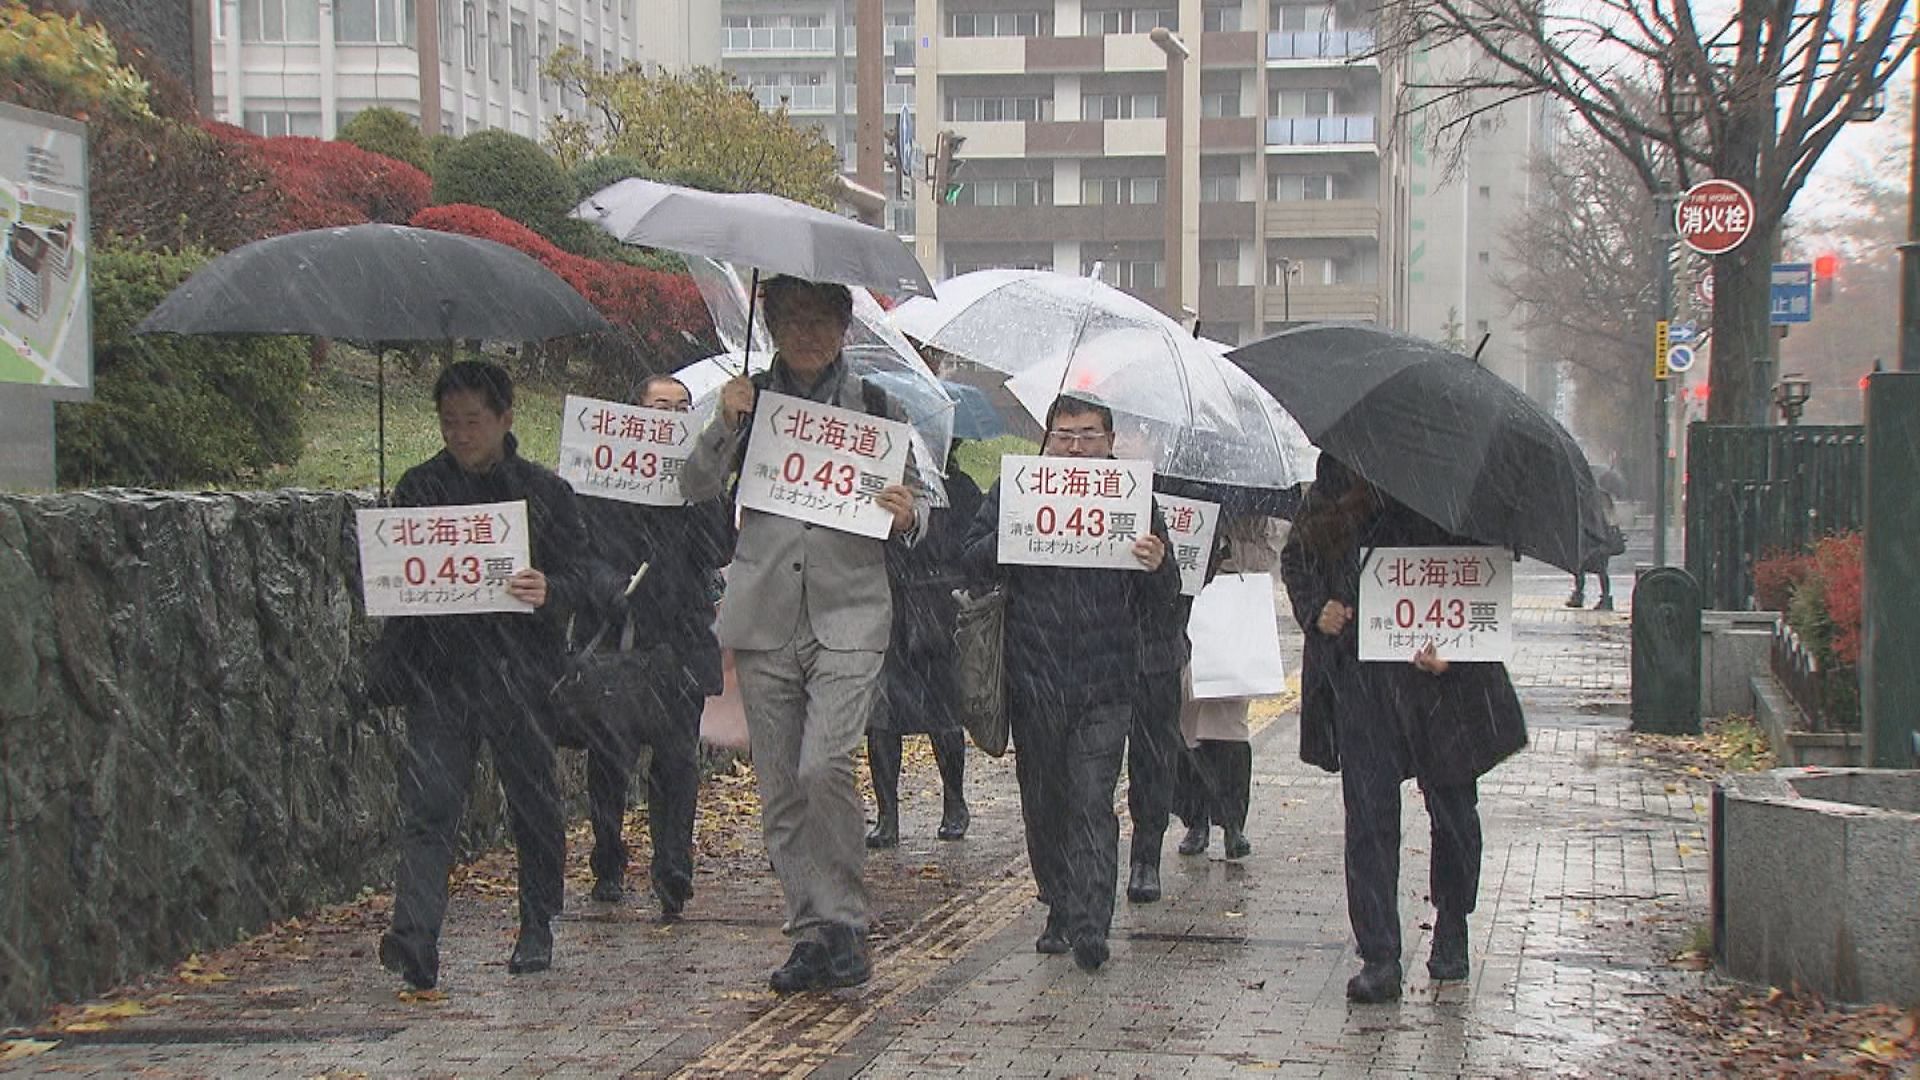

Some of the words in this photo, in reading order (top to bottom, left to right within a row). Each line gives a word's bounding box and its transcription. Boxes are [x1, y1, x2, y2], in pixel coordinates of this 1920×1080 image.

[1682, 204, 1746, 234] 消火栓
[578, 407, 688, 446] 〈北海道〉
[771, 405, 892, 460] 〈北海道〉
[574, 445, 686, 482] 0.43票
[1015, 465, 1137, 498] 〈北海道〉
[769, 484, 860, 518] はオカシイ！
[375, 513, 511, 546] 〈北海道〉
[1159, 504, 1204, 534] 道〉
[1028, 538, 1113, 556] はオカシイ！
[1178, 544, 1200, 570] 票
[1373, 557, 1497, 588] 〈北海道〉
